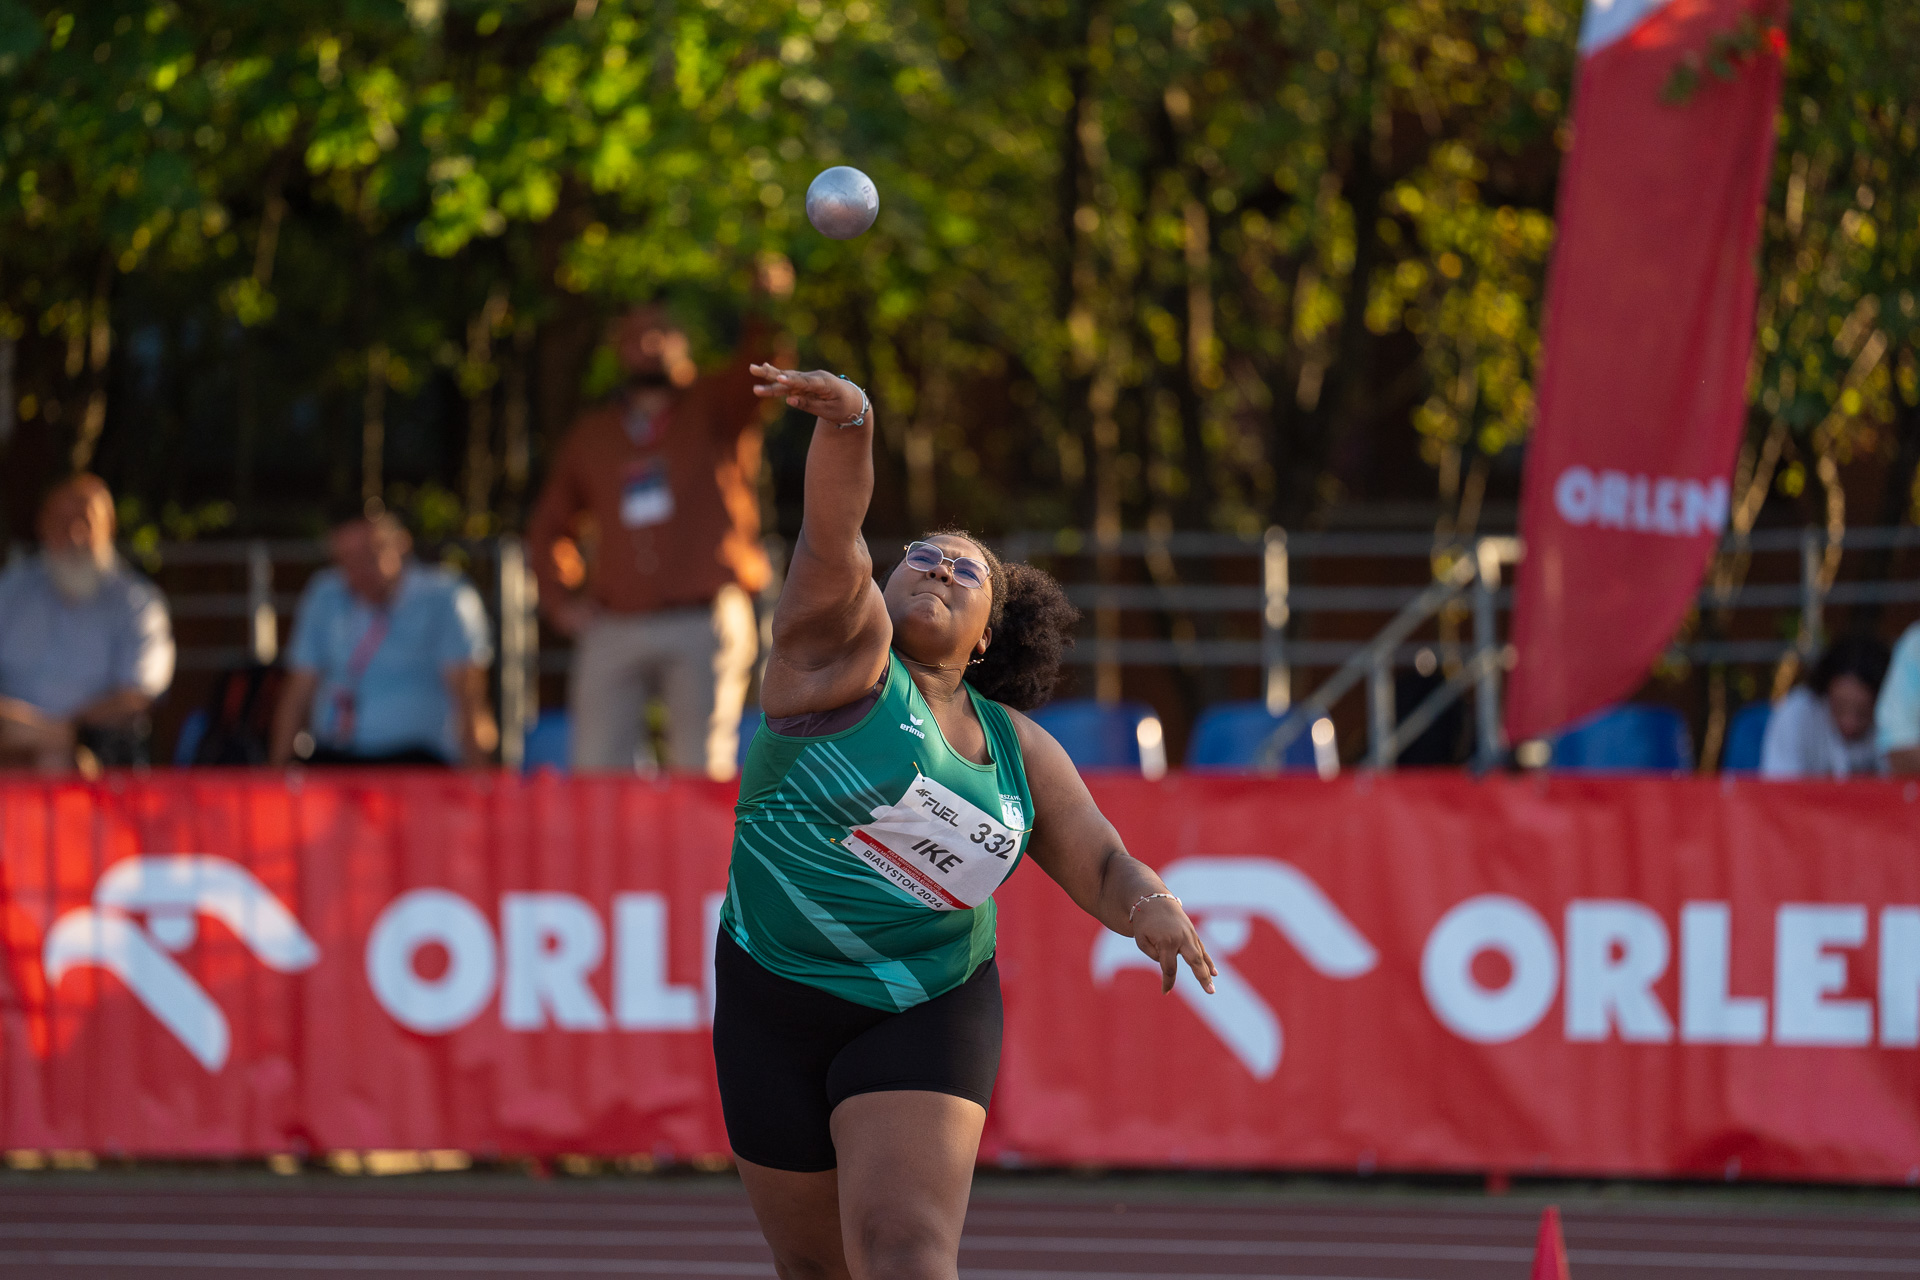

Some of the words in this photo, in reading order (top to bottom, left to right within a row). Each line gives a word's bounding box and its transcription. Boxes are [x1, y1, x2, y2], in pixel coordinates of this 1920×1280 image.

[1554, 465, 1729, 537] ORLEN
[900, 723, 925, 740] erima
[915, 788, 932, 798] 4F
[921, 796, 959, 828] FUEL
[911, 839, 964, 874] IKE
[970, 823, 1015, 860] 332
[863, 850, 918, 892] BIAŁYSTOK
[917, 886, 943, 908] 2024
